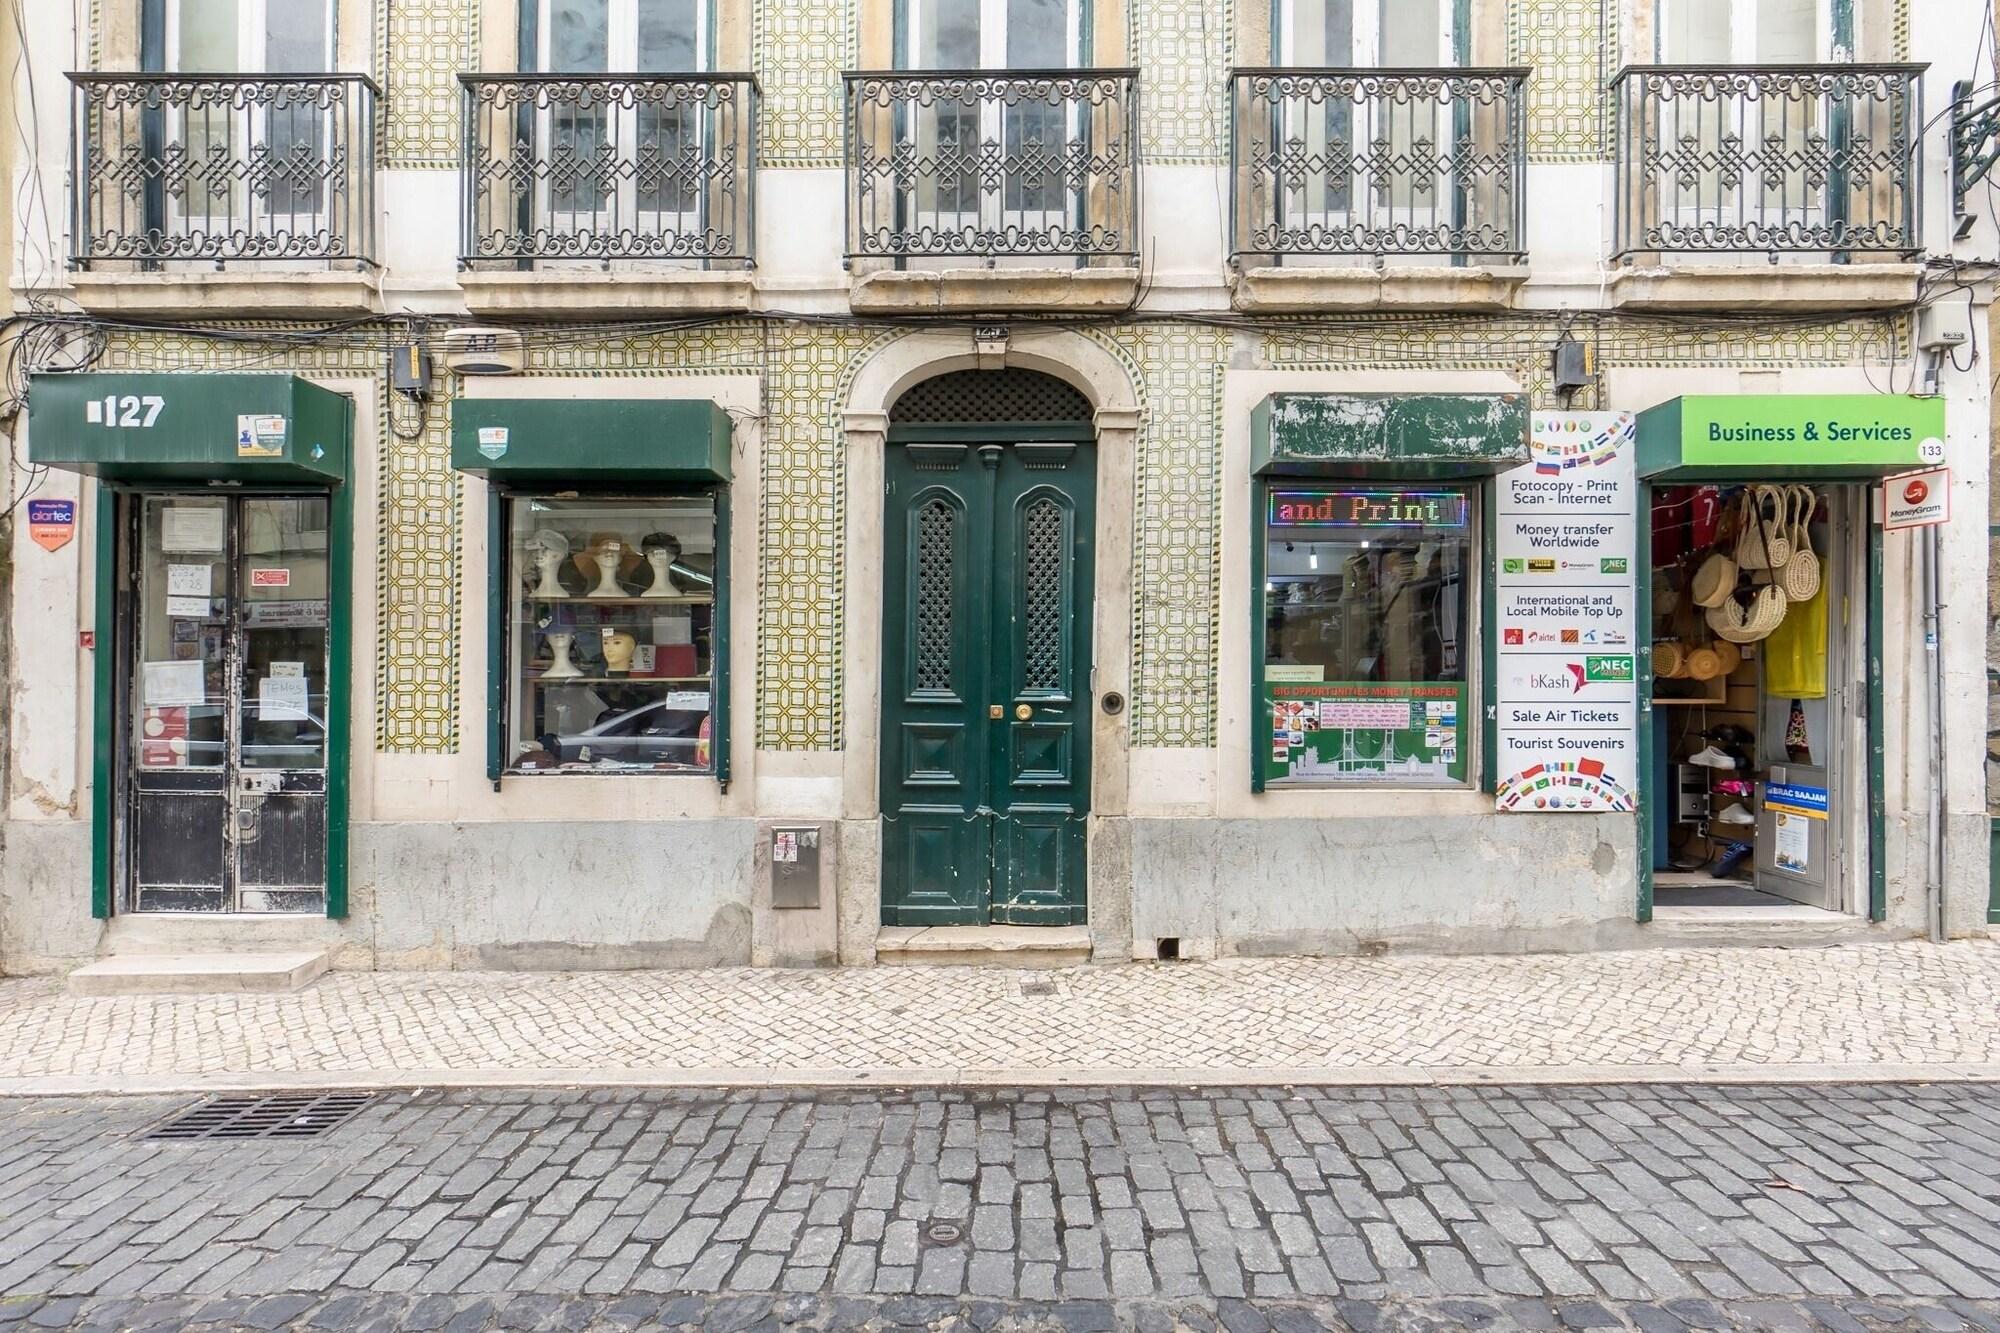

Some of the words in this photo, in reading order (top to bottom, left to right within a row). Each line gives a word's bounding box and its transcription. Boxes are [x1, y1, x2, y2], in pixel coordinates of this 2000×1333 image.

[105, 395, 166, 427] 127
[1709, 422, 1795, 441] Business
[1803, 421, 1819, 441] &
[1827, 421, 1912, 441] Services
[1921, 446, 1942, 456] 133
[1511, 480, 1573, 493] Fotocopy
[1587, 480, 1618, 491] Print
[1514, 493, 1544, 504] Scan
[1558, 492, 1612, 504] Internet
[1280, 499, 1333, 520] and
[1350, 497, 1440, 521] Print
[1704, 498, 1714, 526] 7
[1890, 505, 1941, 517] MoneyGram
[1516, 524, 1559, 537] Money
[1563, 523, 1614, 535] transfer
[1530, 536, 1600, 547] Worldwide
[1610, 559, 1626, 569] NEC
[1516, 595, 1589, 605] International
[1592, 595, 1613, 605] and
[1507, 607, 1537, 616] Local
[1541, 606, 1579, 616] Mobile
[1584, 607, 1604, 618] Top
[1607, 607, 1623, 618] Up
[1538, 632, 1555, 641] airtel
[1600, 660, 1631, 670] NEC
[1531, 674, 1570, 688] bKash
[1274, 687, 1291, 697] BIG
[1294, 687, 1368, 697] OPPORTUNITIES
[1372, 687, 1404, 697] MONEY
[1408, 687, 1458, 697] TRANSFER
[1513, 710, 1541, 721] Sale
[1545, 710, 1566, 721] Air
[1571, 710, 1619, 721] Tickets
[1507, 738, 1553, 748] Tourist
[1558, 738, 1625, 748] Souvenirs
[1773, 787, 1794, 797] BRAC
